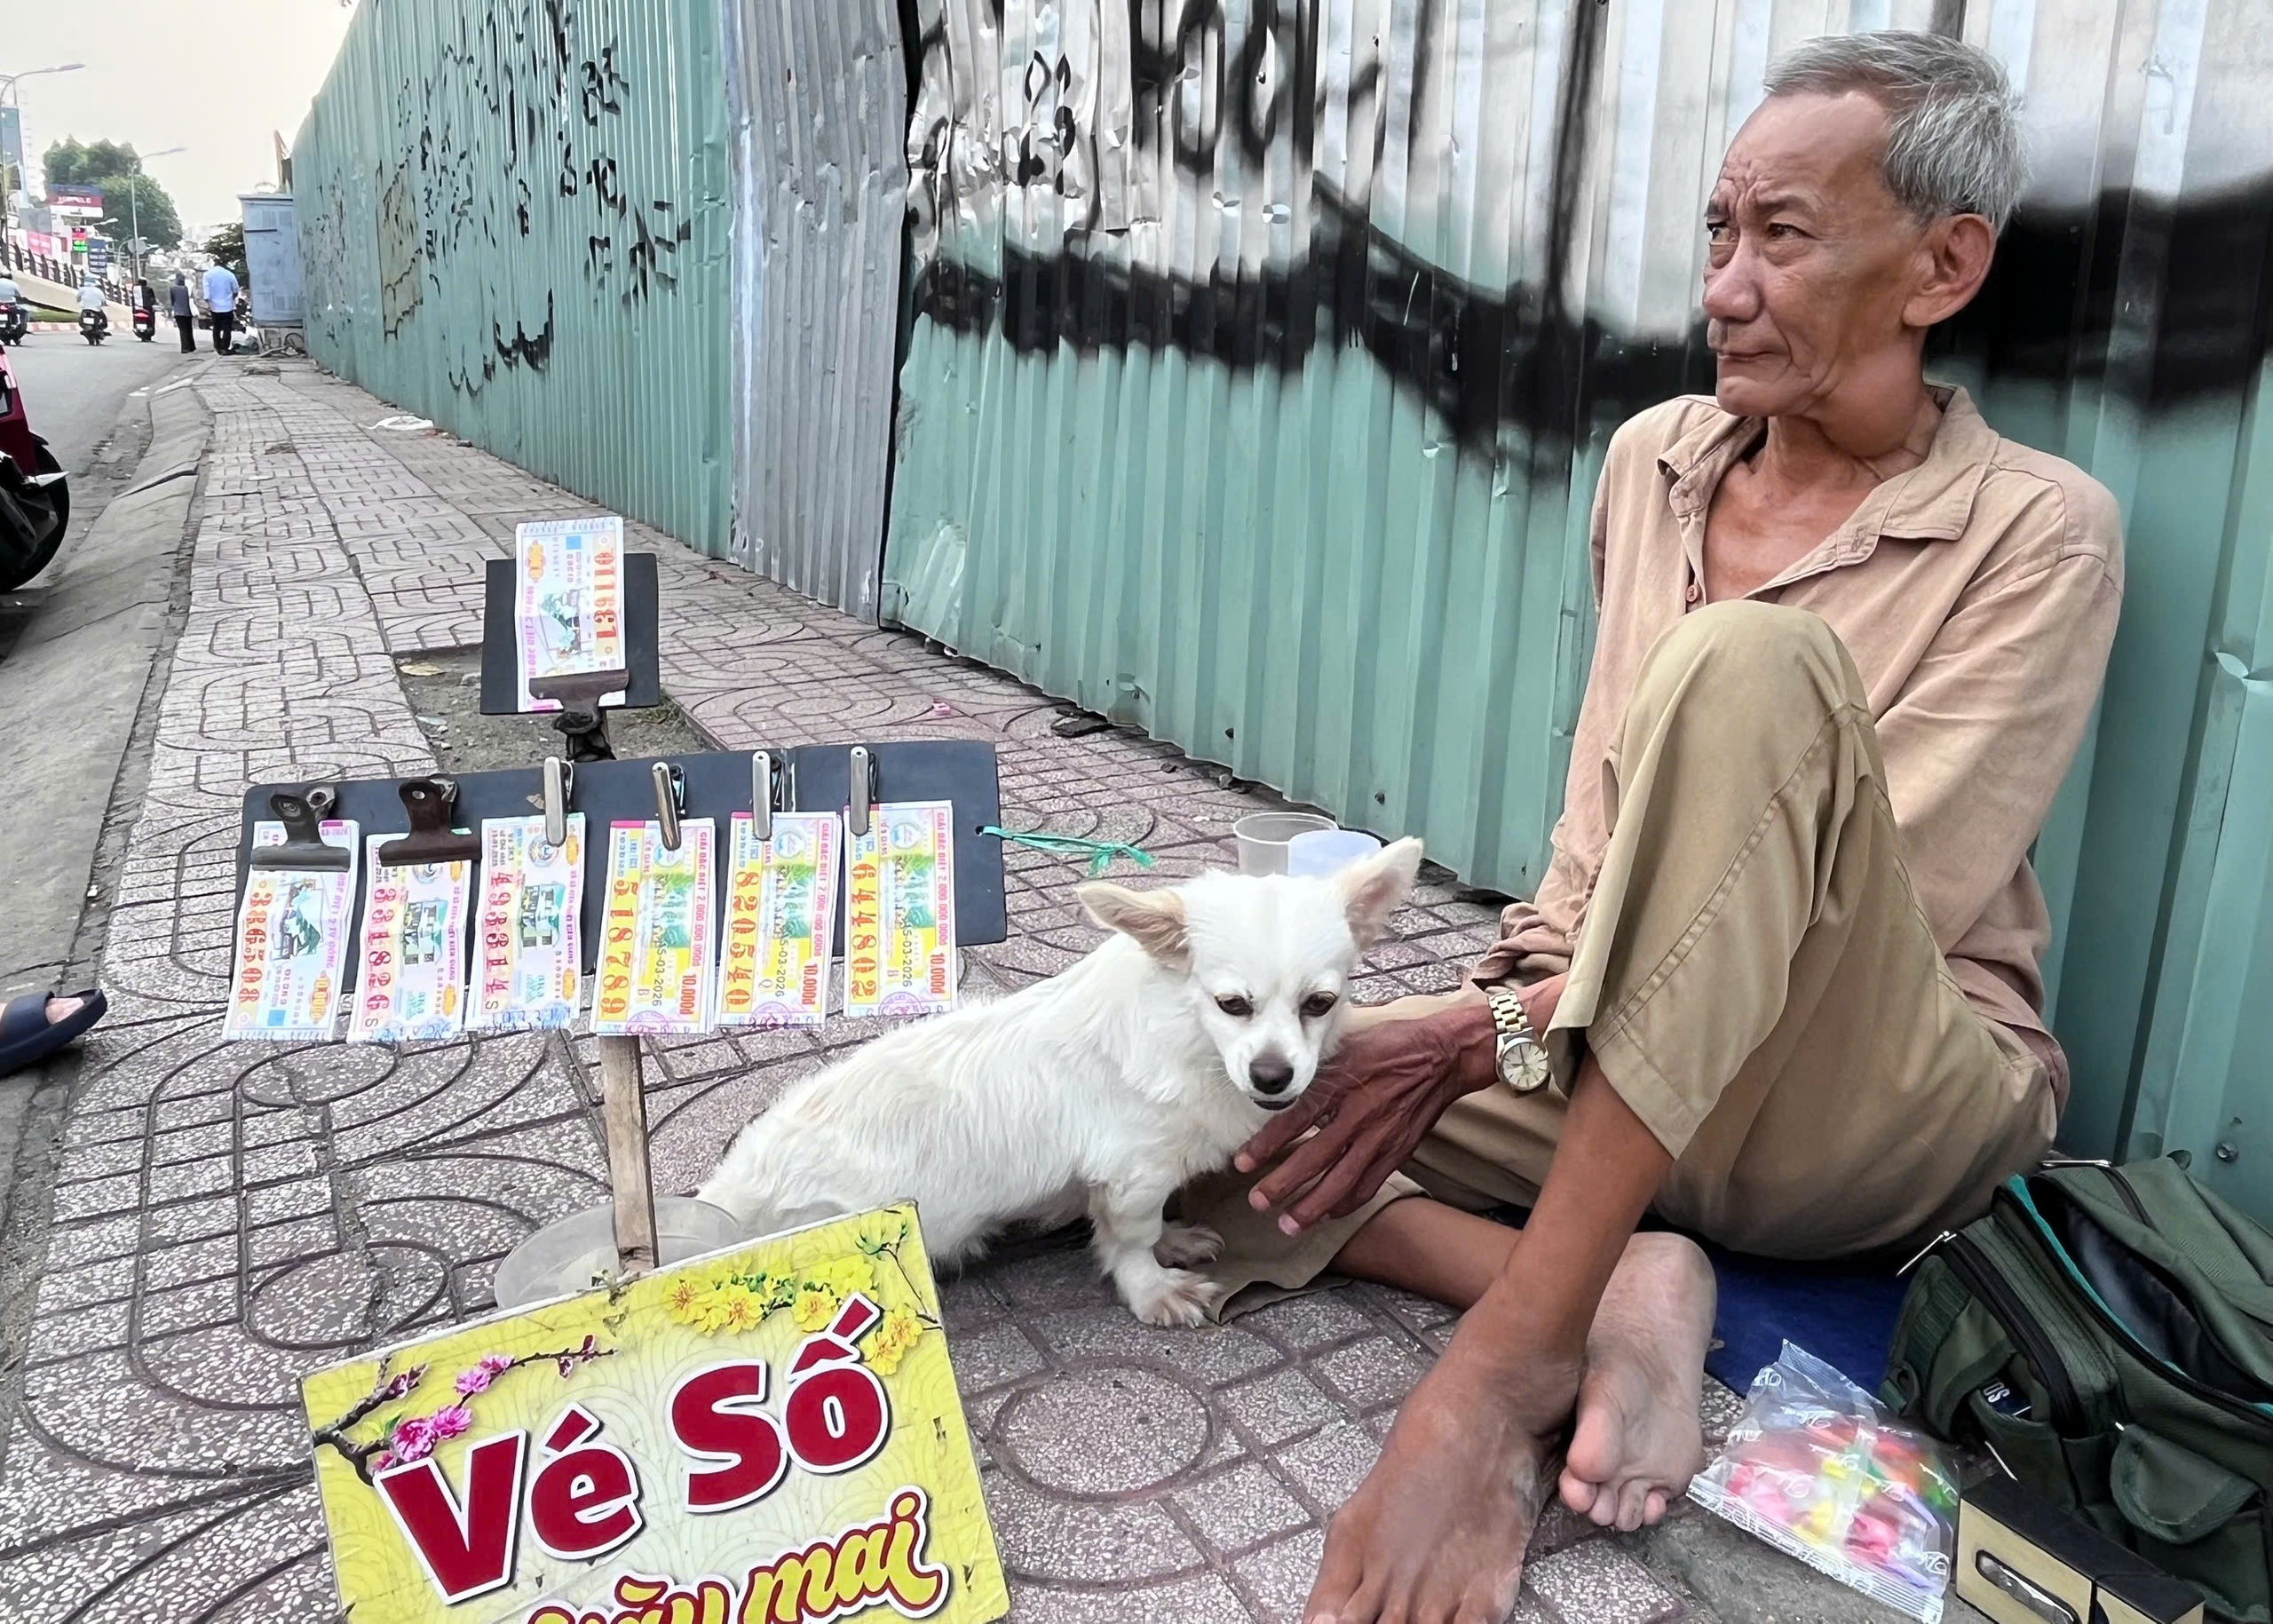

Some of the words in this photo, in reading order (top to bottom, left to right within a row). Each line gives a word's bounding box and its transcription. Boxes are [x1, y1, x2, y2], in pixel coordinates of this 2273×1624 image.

[366, 889, 397, 1011] 331826
[486, 873, 513, 994] 493314
[600, 880, 639, 1015] 518789
[726, 871, 759, 1005] 820540
[851, 864, 877, 999] 644802
[486, 1001, 498, 1010] S
[379, 1406, 638, 1600] Vé
[670, 1297, 885, 1509] Số
[742, 1490, 945, 1624] mai
